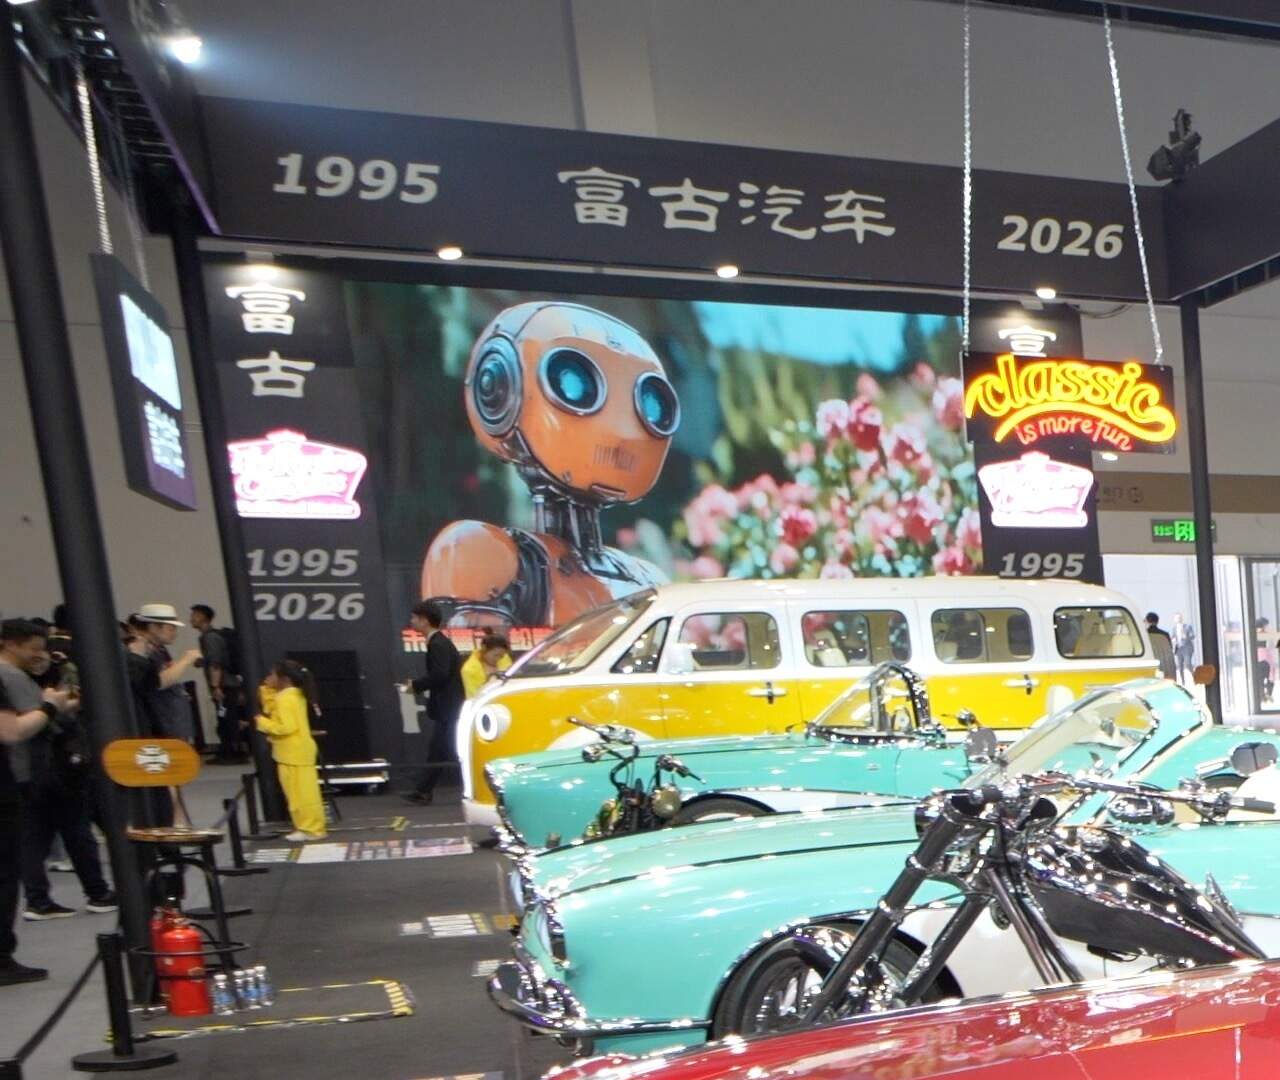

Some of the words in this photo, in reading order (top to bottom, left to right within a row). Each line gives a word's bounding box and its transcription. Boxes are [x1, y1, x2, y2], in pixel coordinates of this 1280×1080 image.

[273, 153, 441, 204] 1995
[557, 167, 896, 245] 富古汽车
[997, 215, 1124, 260] 2026
[225, 282, 315, 398] 富古
[965, 354, 1176, 442] classic
[1015, 425, 1037, 445] is
[1040, 415, 1095, 435] more
[1093, 419, 1133, 451] fun
[246, 549, 359, 577] 1995
[999, 552, 1086, 578] 1995
[253, 593, 365, 620] 2026
